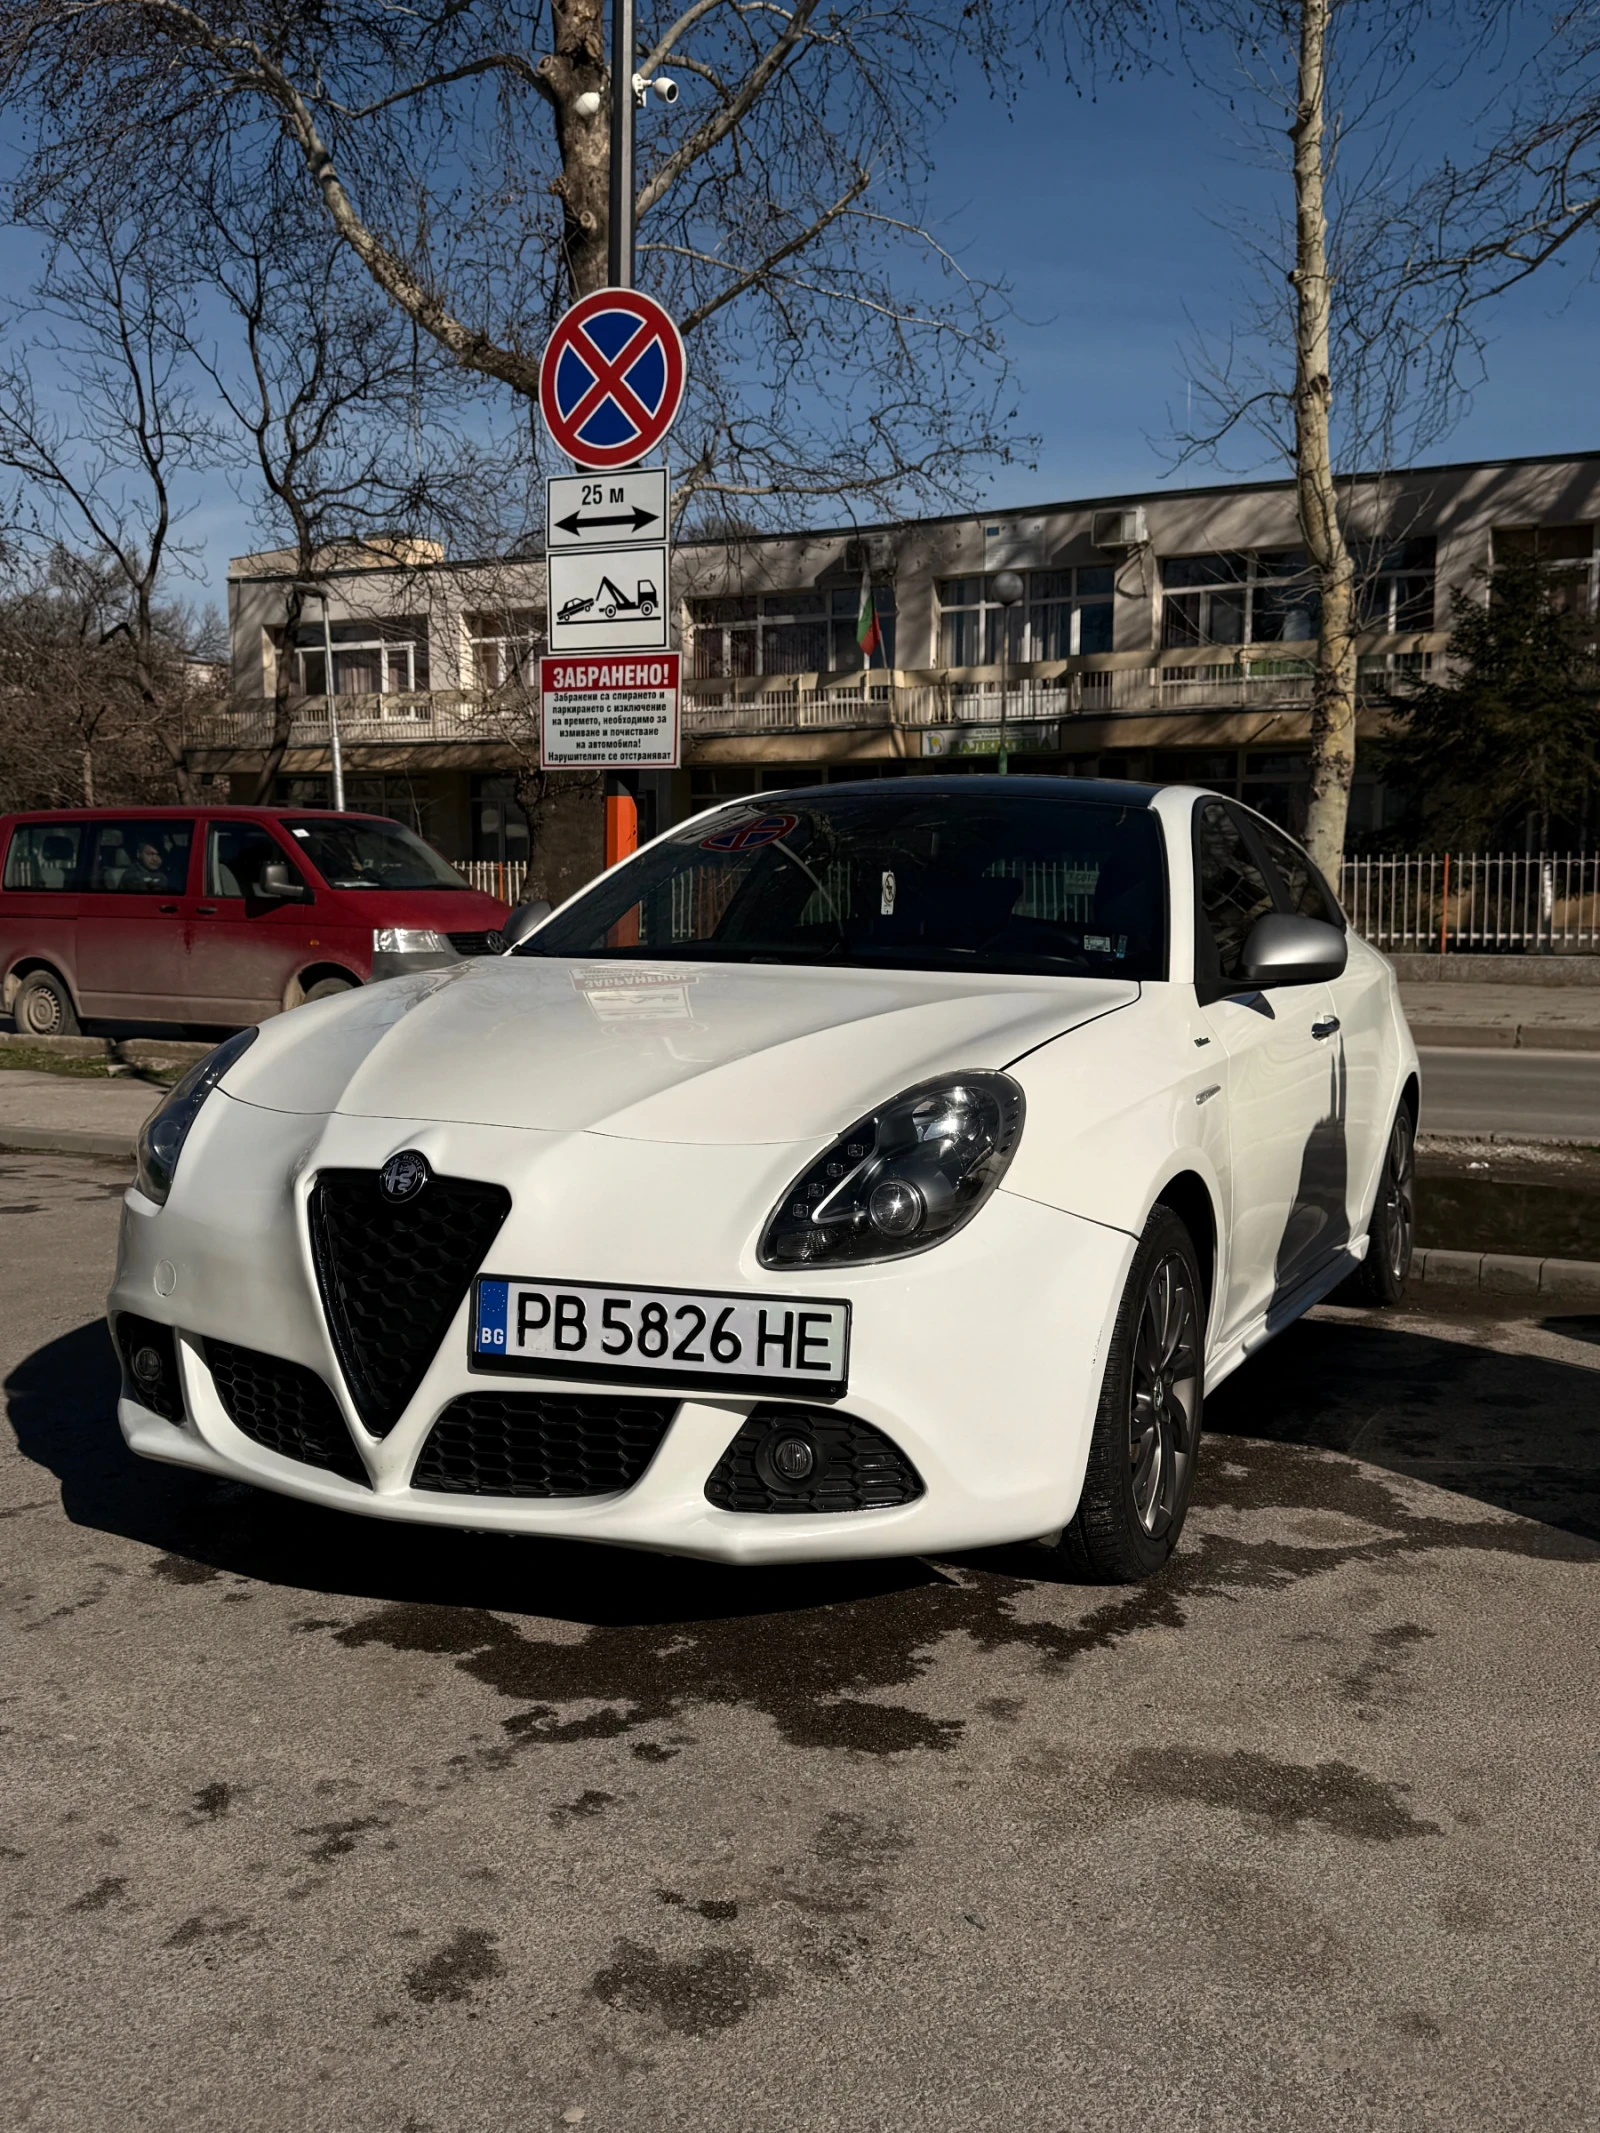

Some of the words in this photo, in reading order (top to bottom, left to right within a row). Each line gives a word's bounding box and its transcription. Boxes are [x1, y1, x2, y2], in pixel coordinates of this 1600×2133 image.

[581, 484, 602, 506] 25
[553, 664, 669, 688] ЗАБРАНЕНО!
[554, 692, 598, 703] Забранени
[600, 693, 610, 701] са
[612, 691, 657, 702] спирането
[552, 705, 604, 716] паркирането
[614, 702, 667, 712] изключение
[552, 717, 562, 726] на
[564, 716, 601, 727] времето,
[603, 714, 655, 726] необходимо
[656, 714, 667, 724] за
[559, 729, 600, 738] измиване
[610, 727, 659, 736] почистване
[576, 740, 586, 749] на
[588, 738, 641, 749] автомобила!
[548, 751, 606, 763] Нарушителите
[608, 752, 618, 761] се
[620, 751, 671, 762] отстраняват
[402, 1154, 424, 1178] ROMEO
[481, 1327, 504, 1346] BG
[516, 1291, 588, 1351] PB
[601, 1298, 743, 1363] 5826
[756, 1309, 832, 1371] HE
